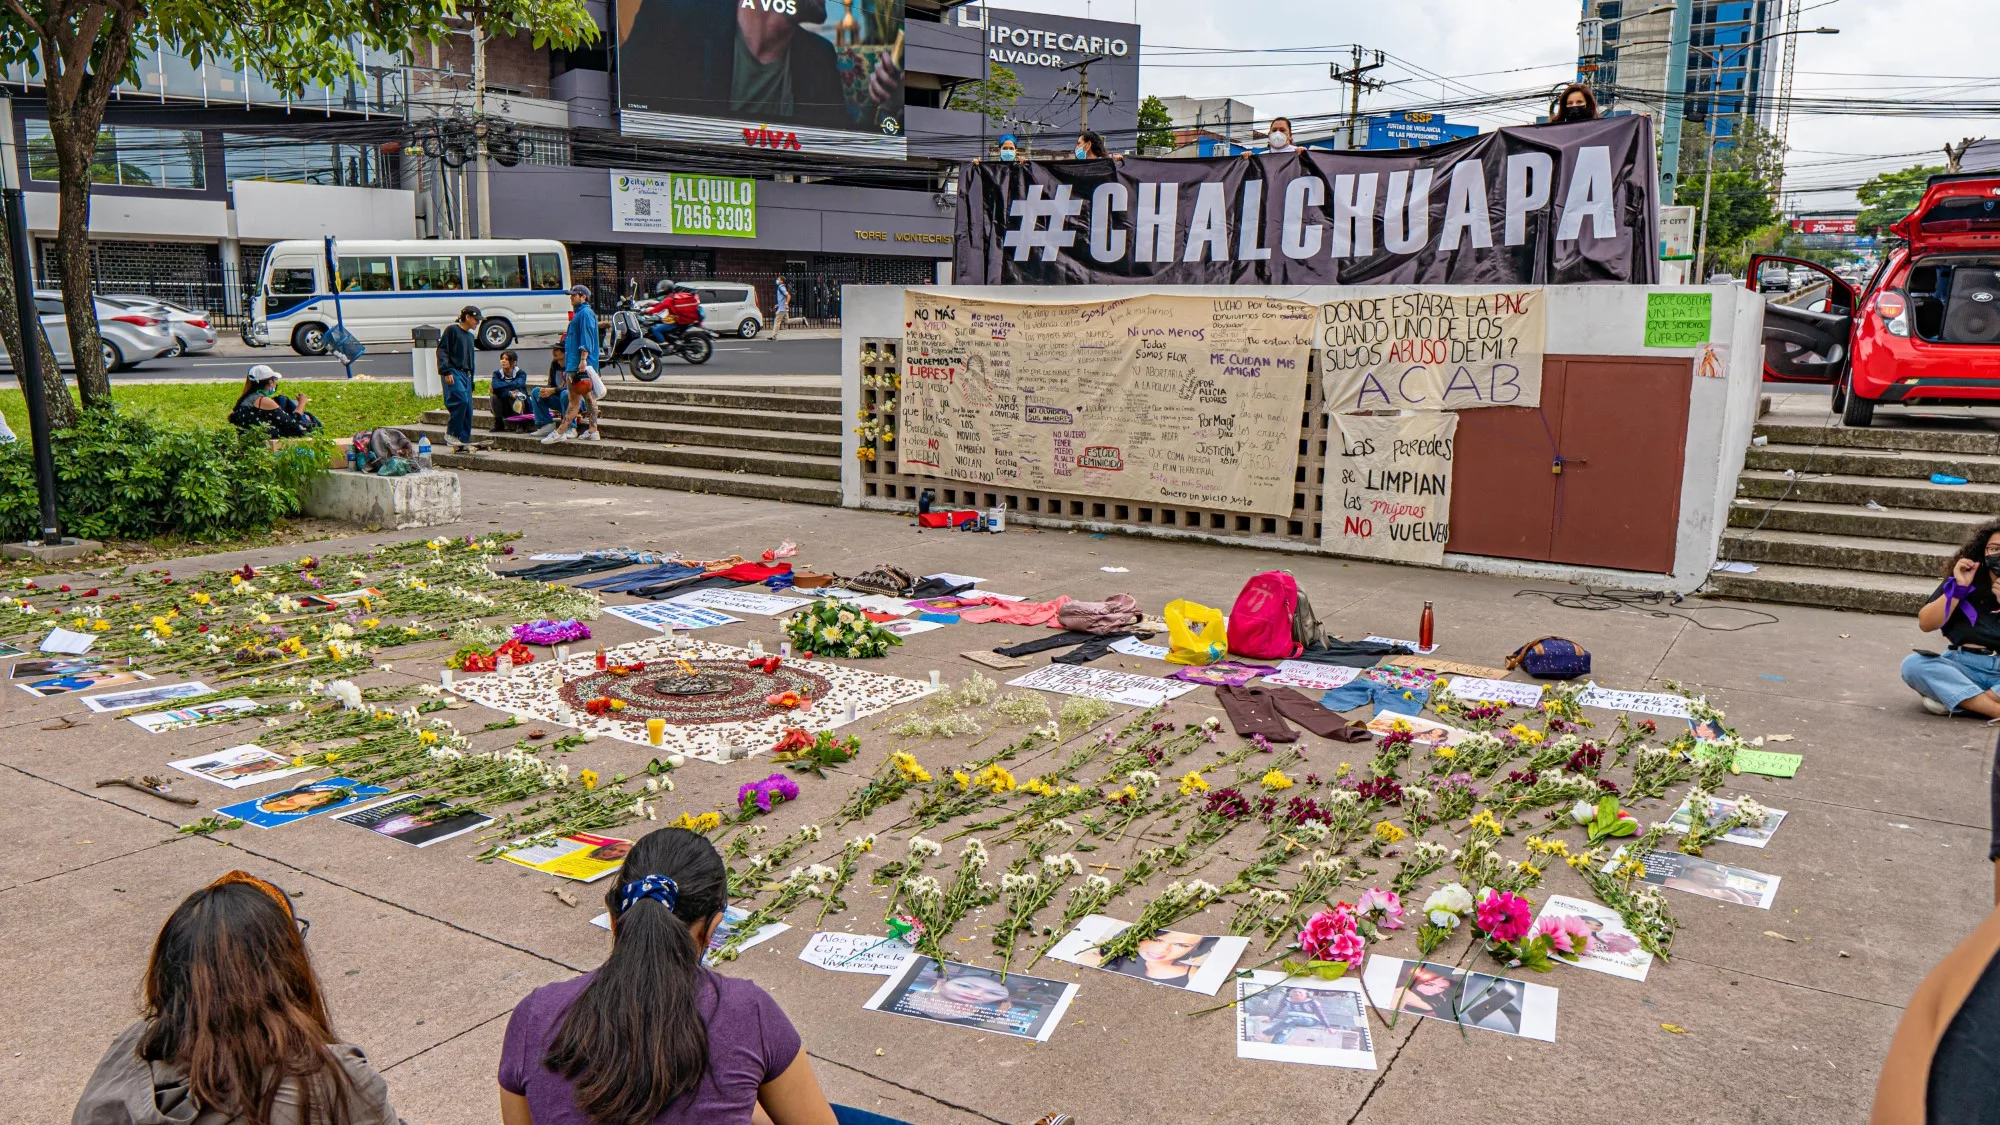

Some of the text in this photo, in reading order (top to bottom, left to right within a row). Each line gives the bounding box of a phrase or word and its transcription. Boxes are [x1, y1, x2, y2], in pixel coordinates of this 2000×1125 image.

[741, 0, 797, 15] A VOS
[989, 25, 1128, 57] IPOTECARIO
[989, 48, 1062, 68] ALVADOR
[1404, 112, 1433, 123] CSSP
[1386, 122, 1405, 131] JUNTAS
[1414, 125, 1441, 133] VIGILANCIA
[674, 177, 752, 205] ALQUILO
[1003, 146, 1617, 262] #CHALCHUAPA
[674, 204, 752, 232] 7856-3303
[855, 231, 954, 244] TORRE MONTECRIST
[1392, 293, 1455, 318] ESTABA
[1466, 298, 1488, 318] LA
[1495, 293, 1529, 316] PNC
[1677, 294, 1711, 305] COSECHA
[1213, 300, 1242, 312] LUCHO
[914, 305, 956, 320] NO MÁS
[1648, 306, 1701, 319] UN PAÍS
[1032, 320, 1058, 329] violencia
[1647, 321, 1669, 331] QUE
[1127, 326, 1139, 337] Ni
[1168, 327, 1205, 341] Menos
[1325, 317, 1503, 348] CUANDO UNO DE LOS
[1141, 339, 1167, 349] Todas
[907, 357, 950, 366] QUEREMOS
[1167, 352, 1188, 364] FLOR
[1210, 353, 1296, 370] ME CUIDAN MIS
[1326, 342, 1382, 372] SUYOS
[1451, 340, 1477, 363] DE
[909, 366, 955, 384] LIBRES!
[1222, 366, 1261, 378] AMIGAS
[906, 378, 924, 394] Hoy
[1199, 379, 1215, 388] POR
[1357, 364, 1521, 409] ACAB
[1199, 388, 1227, 396] ALICIA
[998, 395, 1009, 403] NO
[1199, 396, 1227, 404] FLORES
[995, 403, 1020, 412] VAMOS
[994, 411, 1020, 420] OLVIDAR
[960, 420, 974, 429] LOS
[956, 431, 980, 441] NOVIOS
[1064, 431, 1087, 439] QUIERO
[928, 438, 939, 450] NO
[955, 443, 986, 454] TAMBIÉN
[1054, 439, 1072, 447] TENER
[1341, 431, 1375, 457] Las
[905, 449, 940, 465] PUEDEN
[955, 456, 982, 468] VIOLAN
[969, 470, 978, 479] ES
[1054, 469, 1073, 477] CALLES
[1341, 469, 1446, 496] se LIMPIAN
[1343, 488, 1362, 511] las
[1344, 515, 1449, 543] NO VUELVEN
[1580, 952, 1614, 962] NCONTRAR
